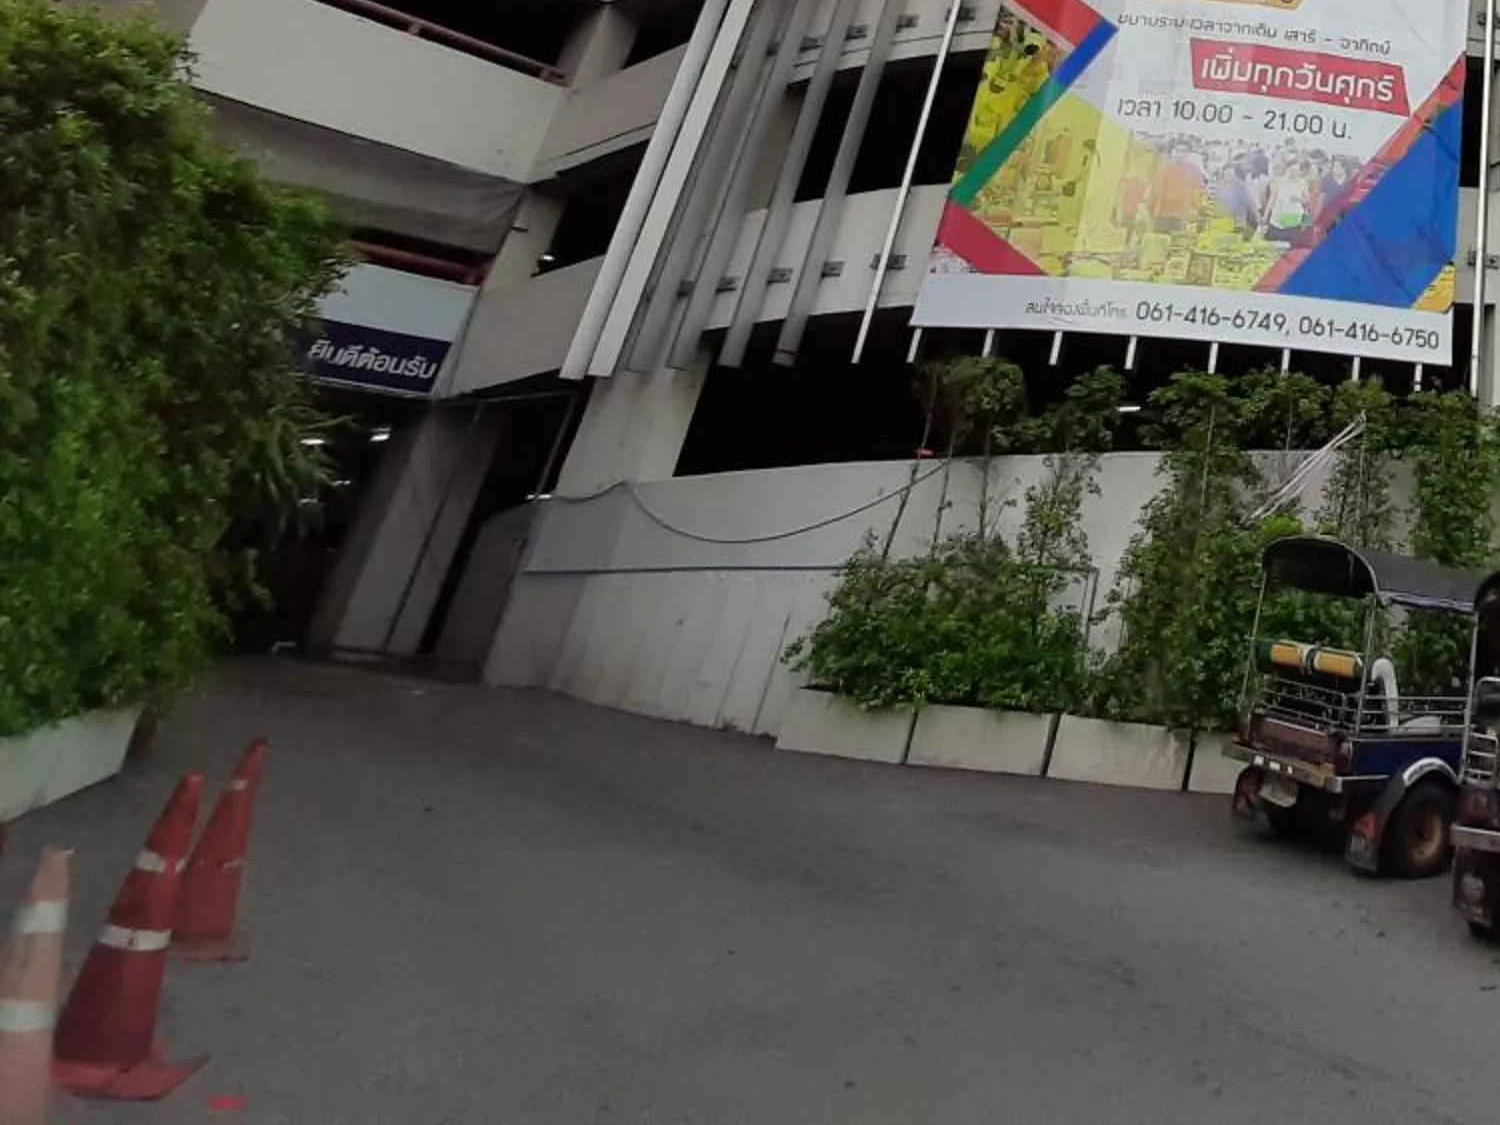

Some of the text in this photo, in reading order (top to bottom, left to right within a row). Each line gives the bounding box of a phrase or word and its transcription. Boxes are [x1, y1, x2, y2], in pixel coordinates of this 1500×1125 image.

[1201, 48, 1394, 105] เพิ่มทุกวันศุกร์
[1117, 98, 1161, 118] เวลา
[1172, 100, 1233, 124] 10.00
[1263, 110, 1323, 133] 21.00
[1332, 120, 1352, 139] น.
[1135, 300, 1290, 337] 061-416-6749,
[1299, 315, 1439, 350] 061-416-6750
[308, 339, 438, 379] ยินดีต้อนรับ
